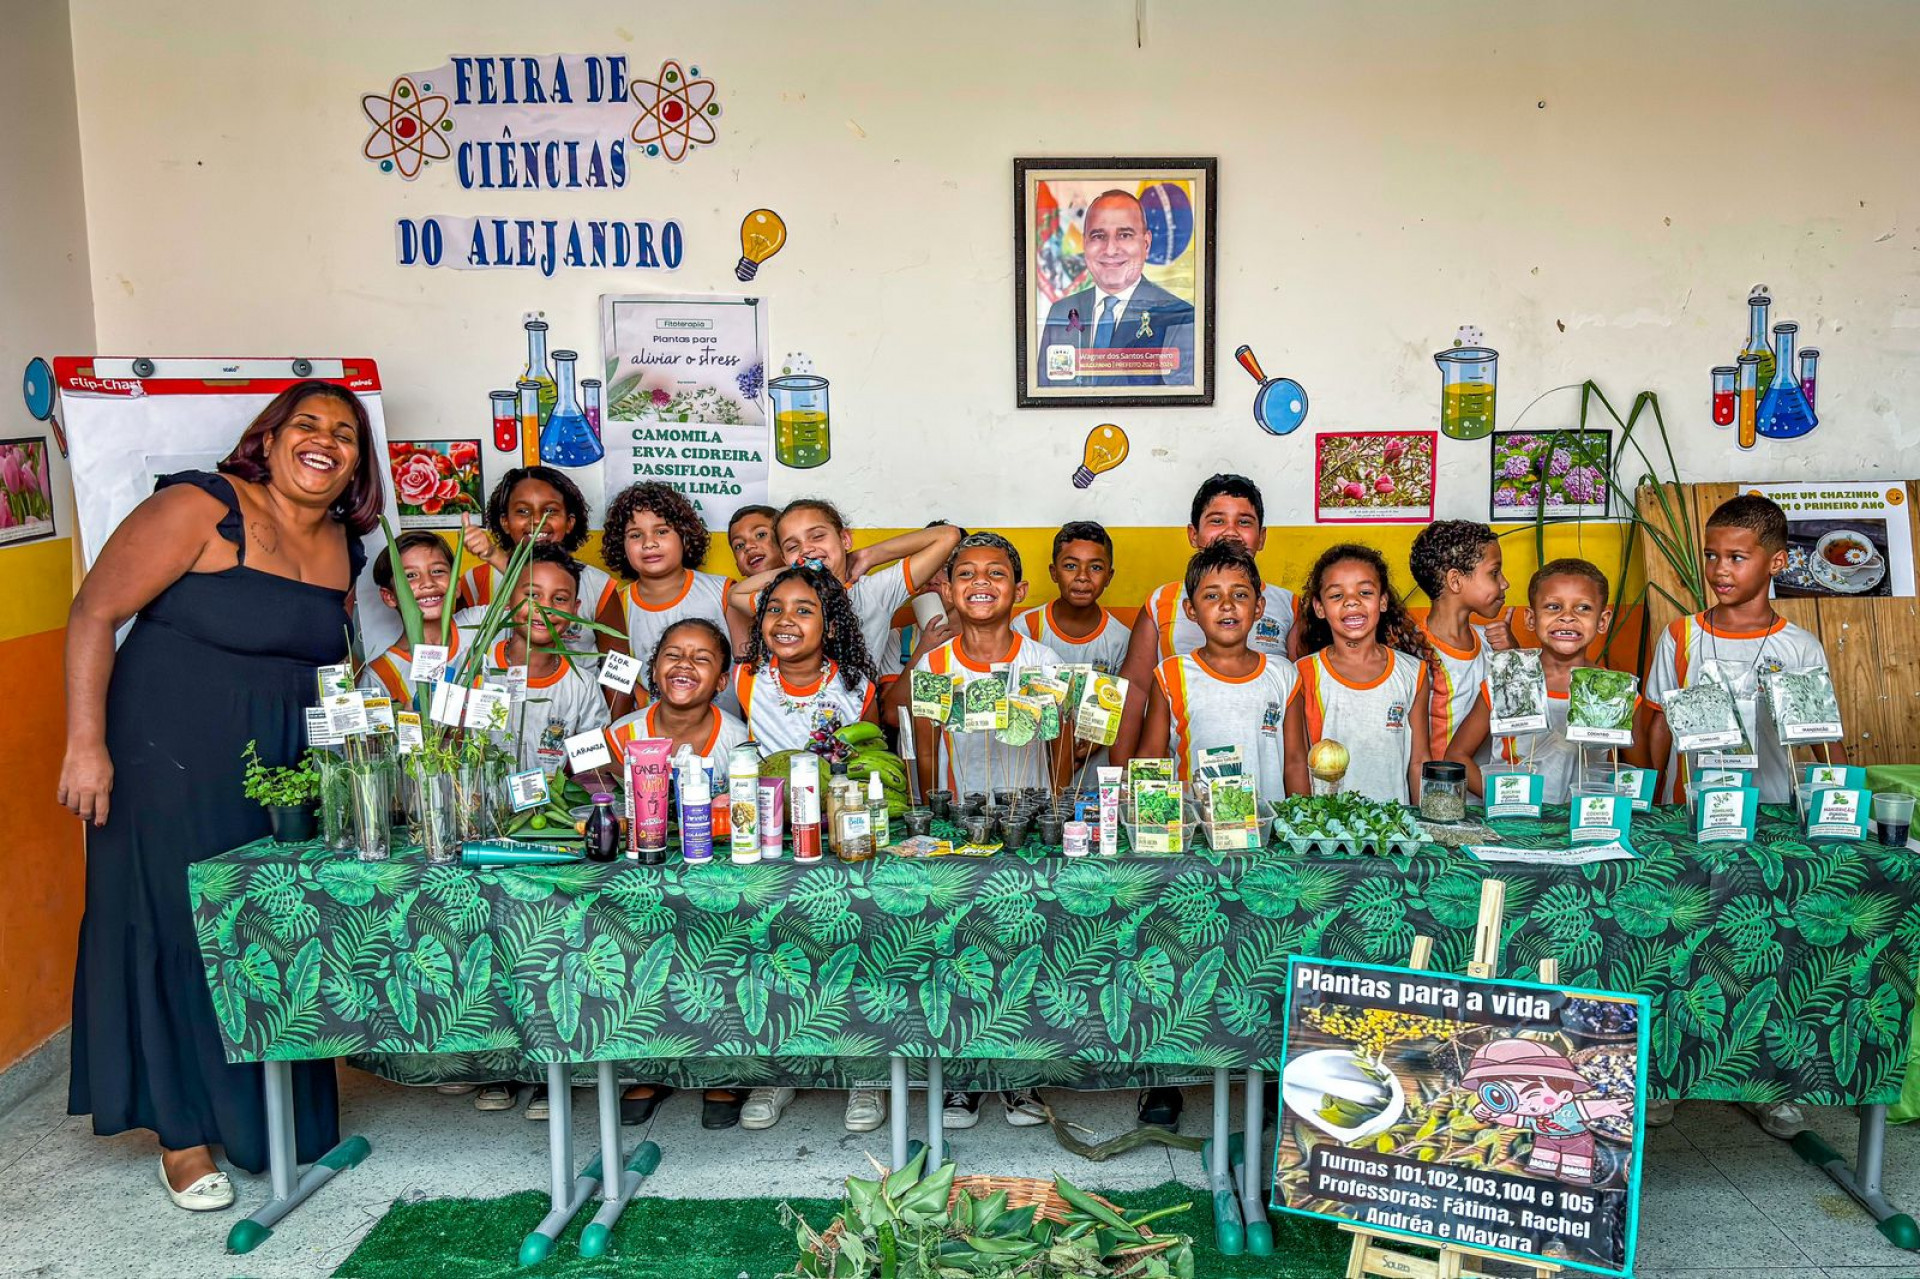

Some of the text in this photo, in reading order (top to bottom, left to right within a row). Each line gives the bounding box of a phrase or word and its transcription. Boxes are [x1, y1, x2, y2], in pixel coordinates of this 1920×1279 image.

[451, 55, 629, 105] FEIRA DE
[456, 125, 627, 190] CIÊNCIAS
[397, 218, 684, 277] DO ALEJANDRO
[653, 335, 717, 344] Plantas para
[630, 345, 741, 367] aliviar o stress
[1079, 353, 1106, 361] Wagner
[1107, 352, 1120, 360] dos
[1120, 352, 1144, 360] Santos
[632, 428, 723, 443] CAMOMILA
[632, 446, 763, 463] ERVA CIDREIRA
[632, 463, 735, 478] PASSIFLORA
[689, 480, 742, 495] LIMÃO
[1768, 491, 1880, 500] TOME UM CHAZINHO
[1794, 502, 1801, 510] O
[1804, 502, 1858, 510] PRIMEIRO
[1861, 502, 1885, 510] ANO
[607, 662, 619, 671] DA
[609, 653, 630, 668] FLOR
[571, 743, 605, 758] LARANJA
[634, 763, 669, 775] CANELA
[1297, 966, 1552, 1021] Plantas para a vida
[1319, 1150, 1595, 1214] Turmas 101,102,103,104 e 105
[1319, 1174, 1591, 1239] Professoras: Fátima, Rachel
[1366, 1206, 1532, 1253] Andréa e Mayara
